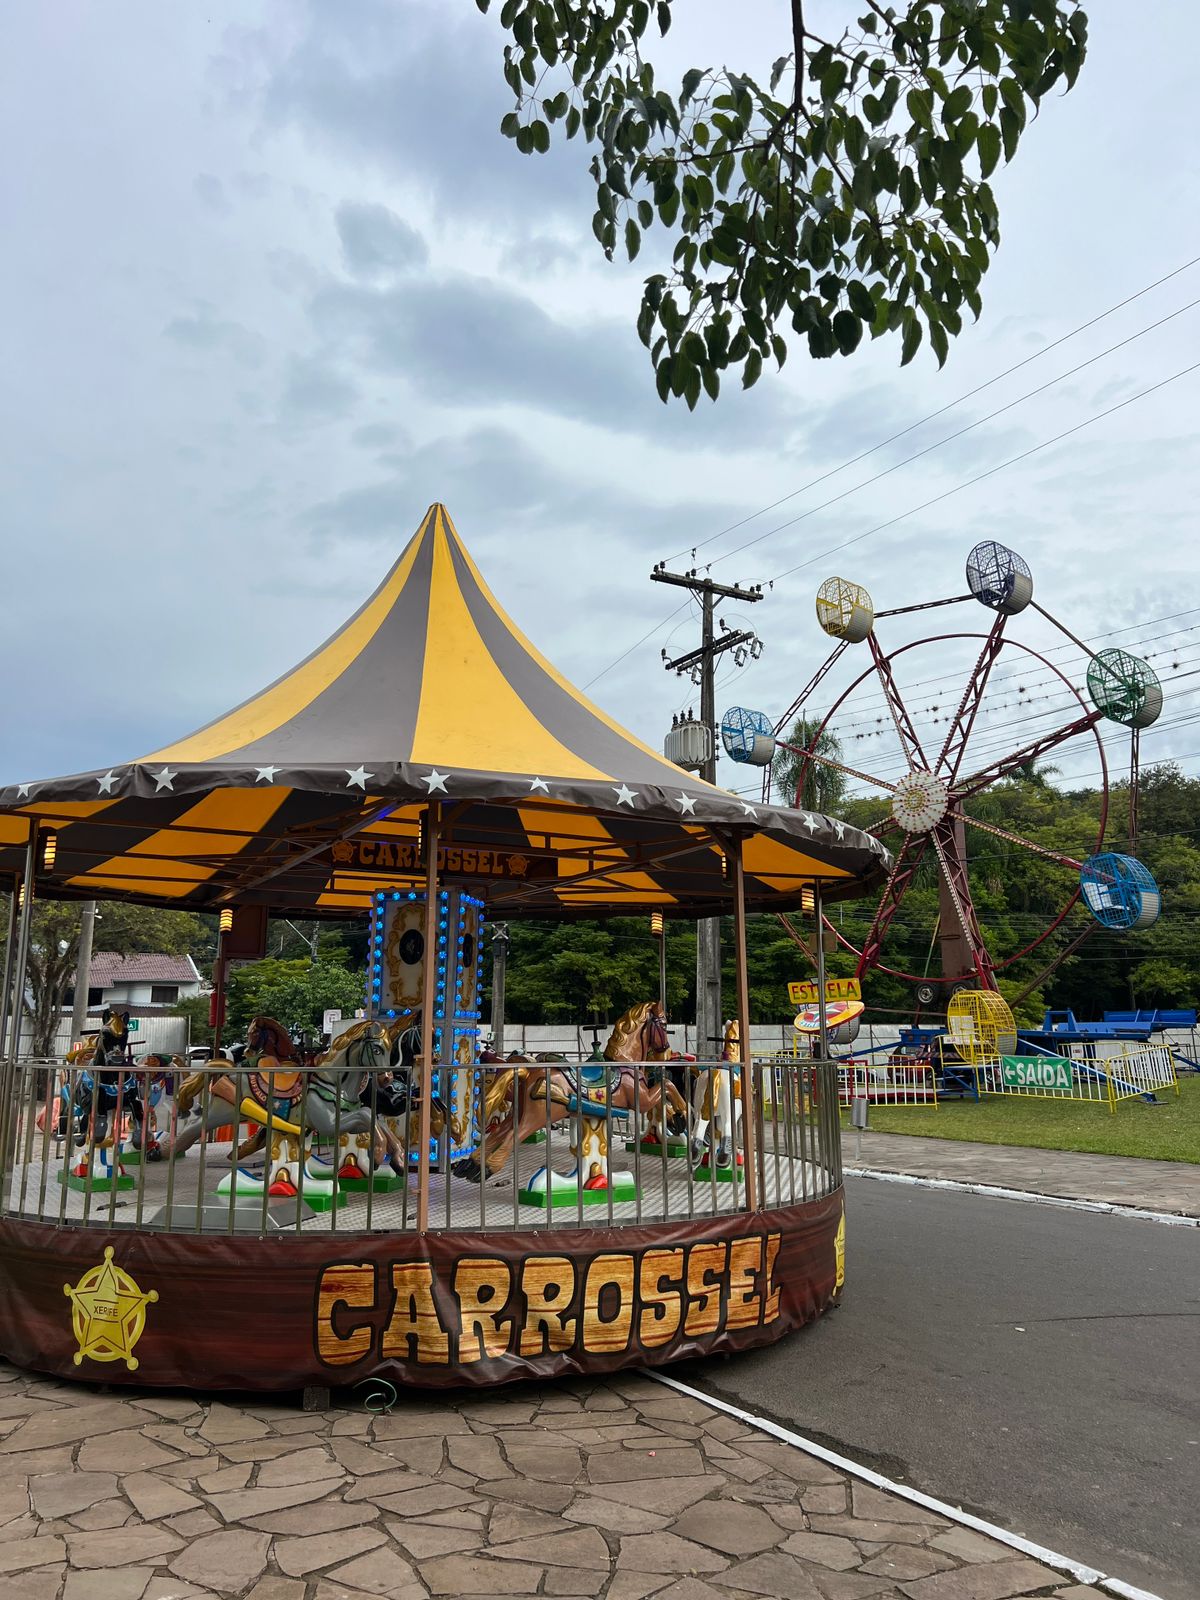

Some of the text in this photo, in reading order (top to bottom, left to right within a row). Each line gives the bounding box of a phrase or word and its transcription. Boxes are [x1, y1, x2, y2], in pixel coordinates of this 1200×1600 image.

[791, 981, 858, 1000] ESTELA
[1016, 1059, 1070, 1087] SAÍDA
[316, 1231, 782, 1366] CARROSSEL
[93, 1305, 118, 1317] XERFE
